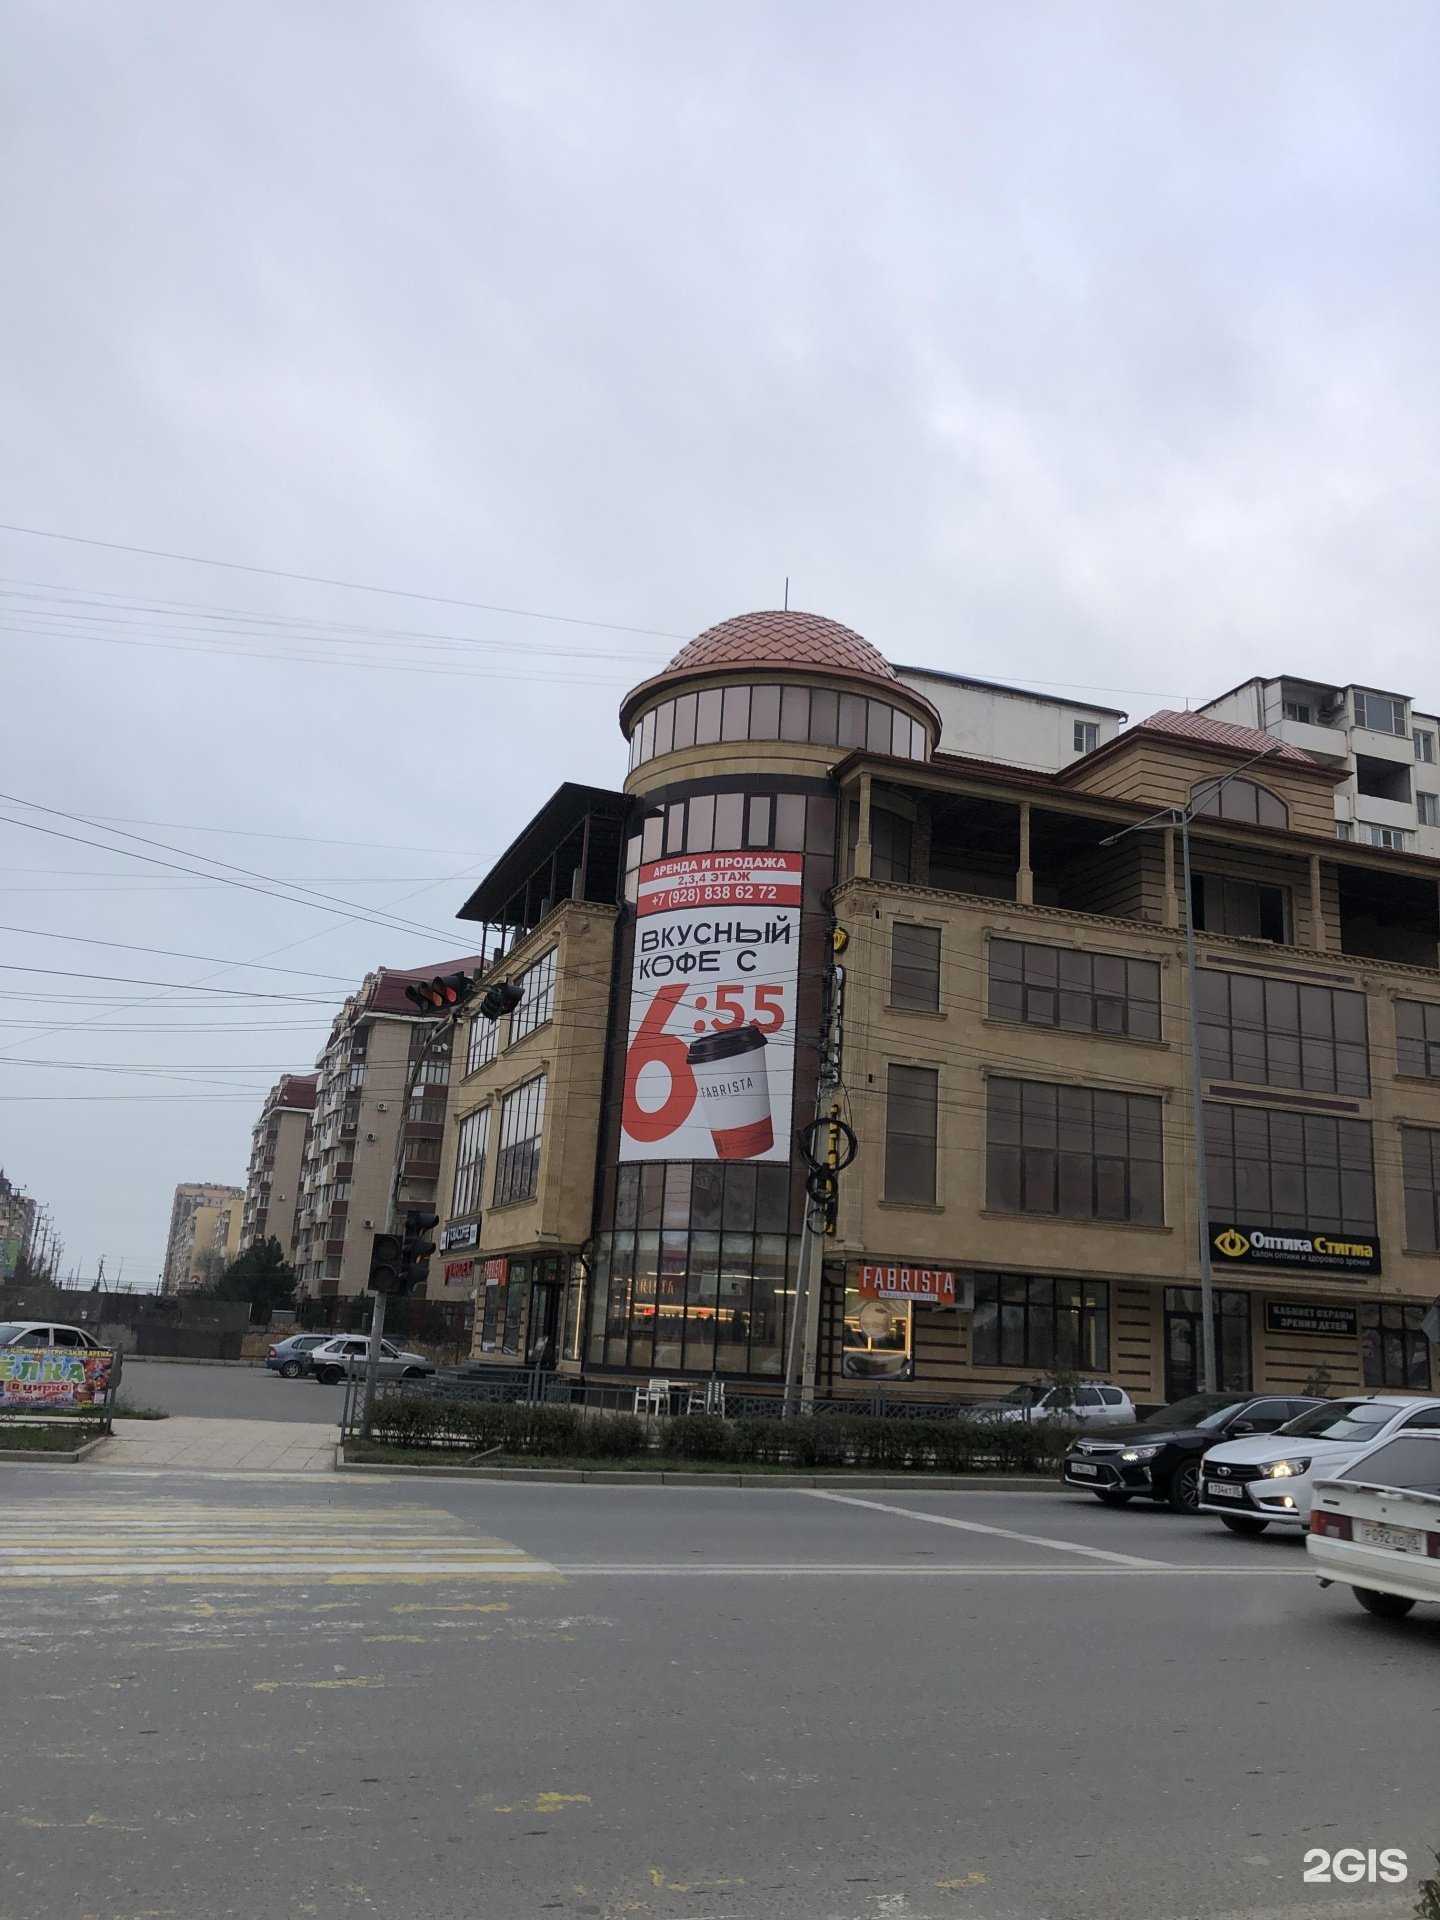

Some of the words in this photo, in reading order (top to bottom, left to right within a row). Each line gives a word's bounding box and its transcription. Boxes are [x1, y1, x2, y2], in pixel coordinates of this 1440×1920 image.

[653, 860, 698, 878] АРЕНДА
[702, 859, 711, 869] И
[715, 857, 787, 872] ПРОДАЖА
[678, 873, 706, 886] 2,3,4
[710, 871, 751, 882] ЭТАЖ
[652, 893, 665, 906] +7
[668, 888, 700, 907] (928)
[704, 886, 731, 900] 838
[735, 886, 752, 899] 62
[759, 886, 777, 899] 72
[641, 915, 791, 953] ВКУСНЫЙ
[639, 950, 721, 980] КОФЕ
[736, 950, 758, 972] С
[701, 1077, 753, 1098] FABRISTA
[1250, 1231, 1313, 1252] Оптика
[1314, 1237, 1373, 1258] Стигма
[863, 1266, 954, 1294] FABRISTA
